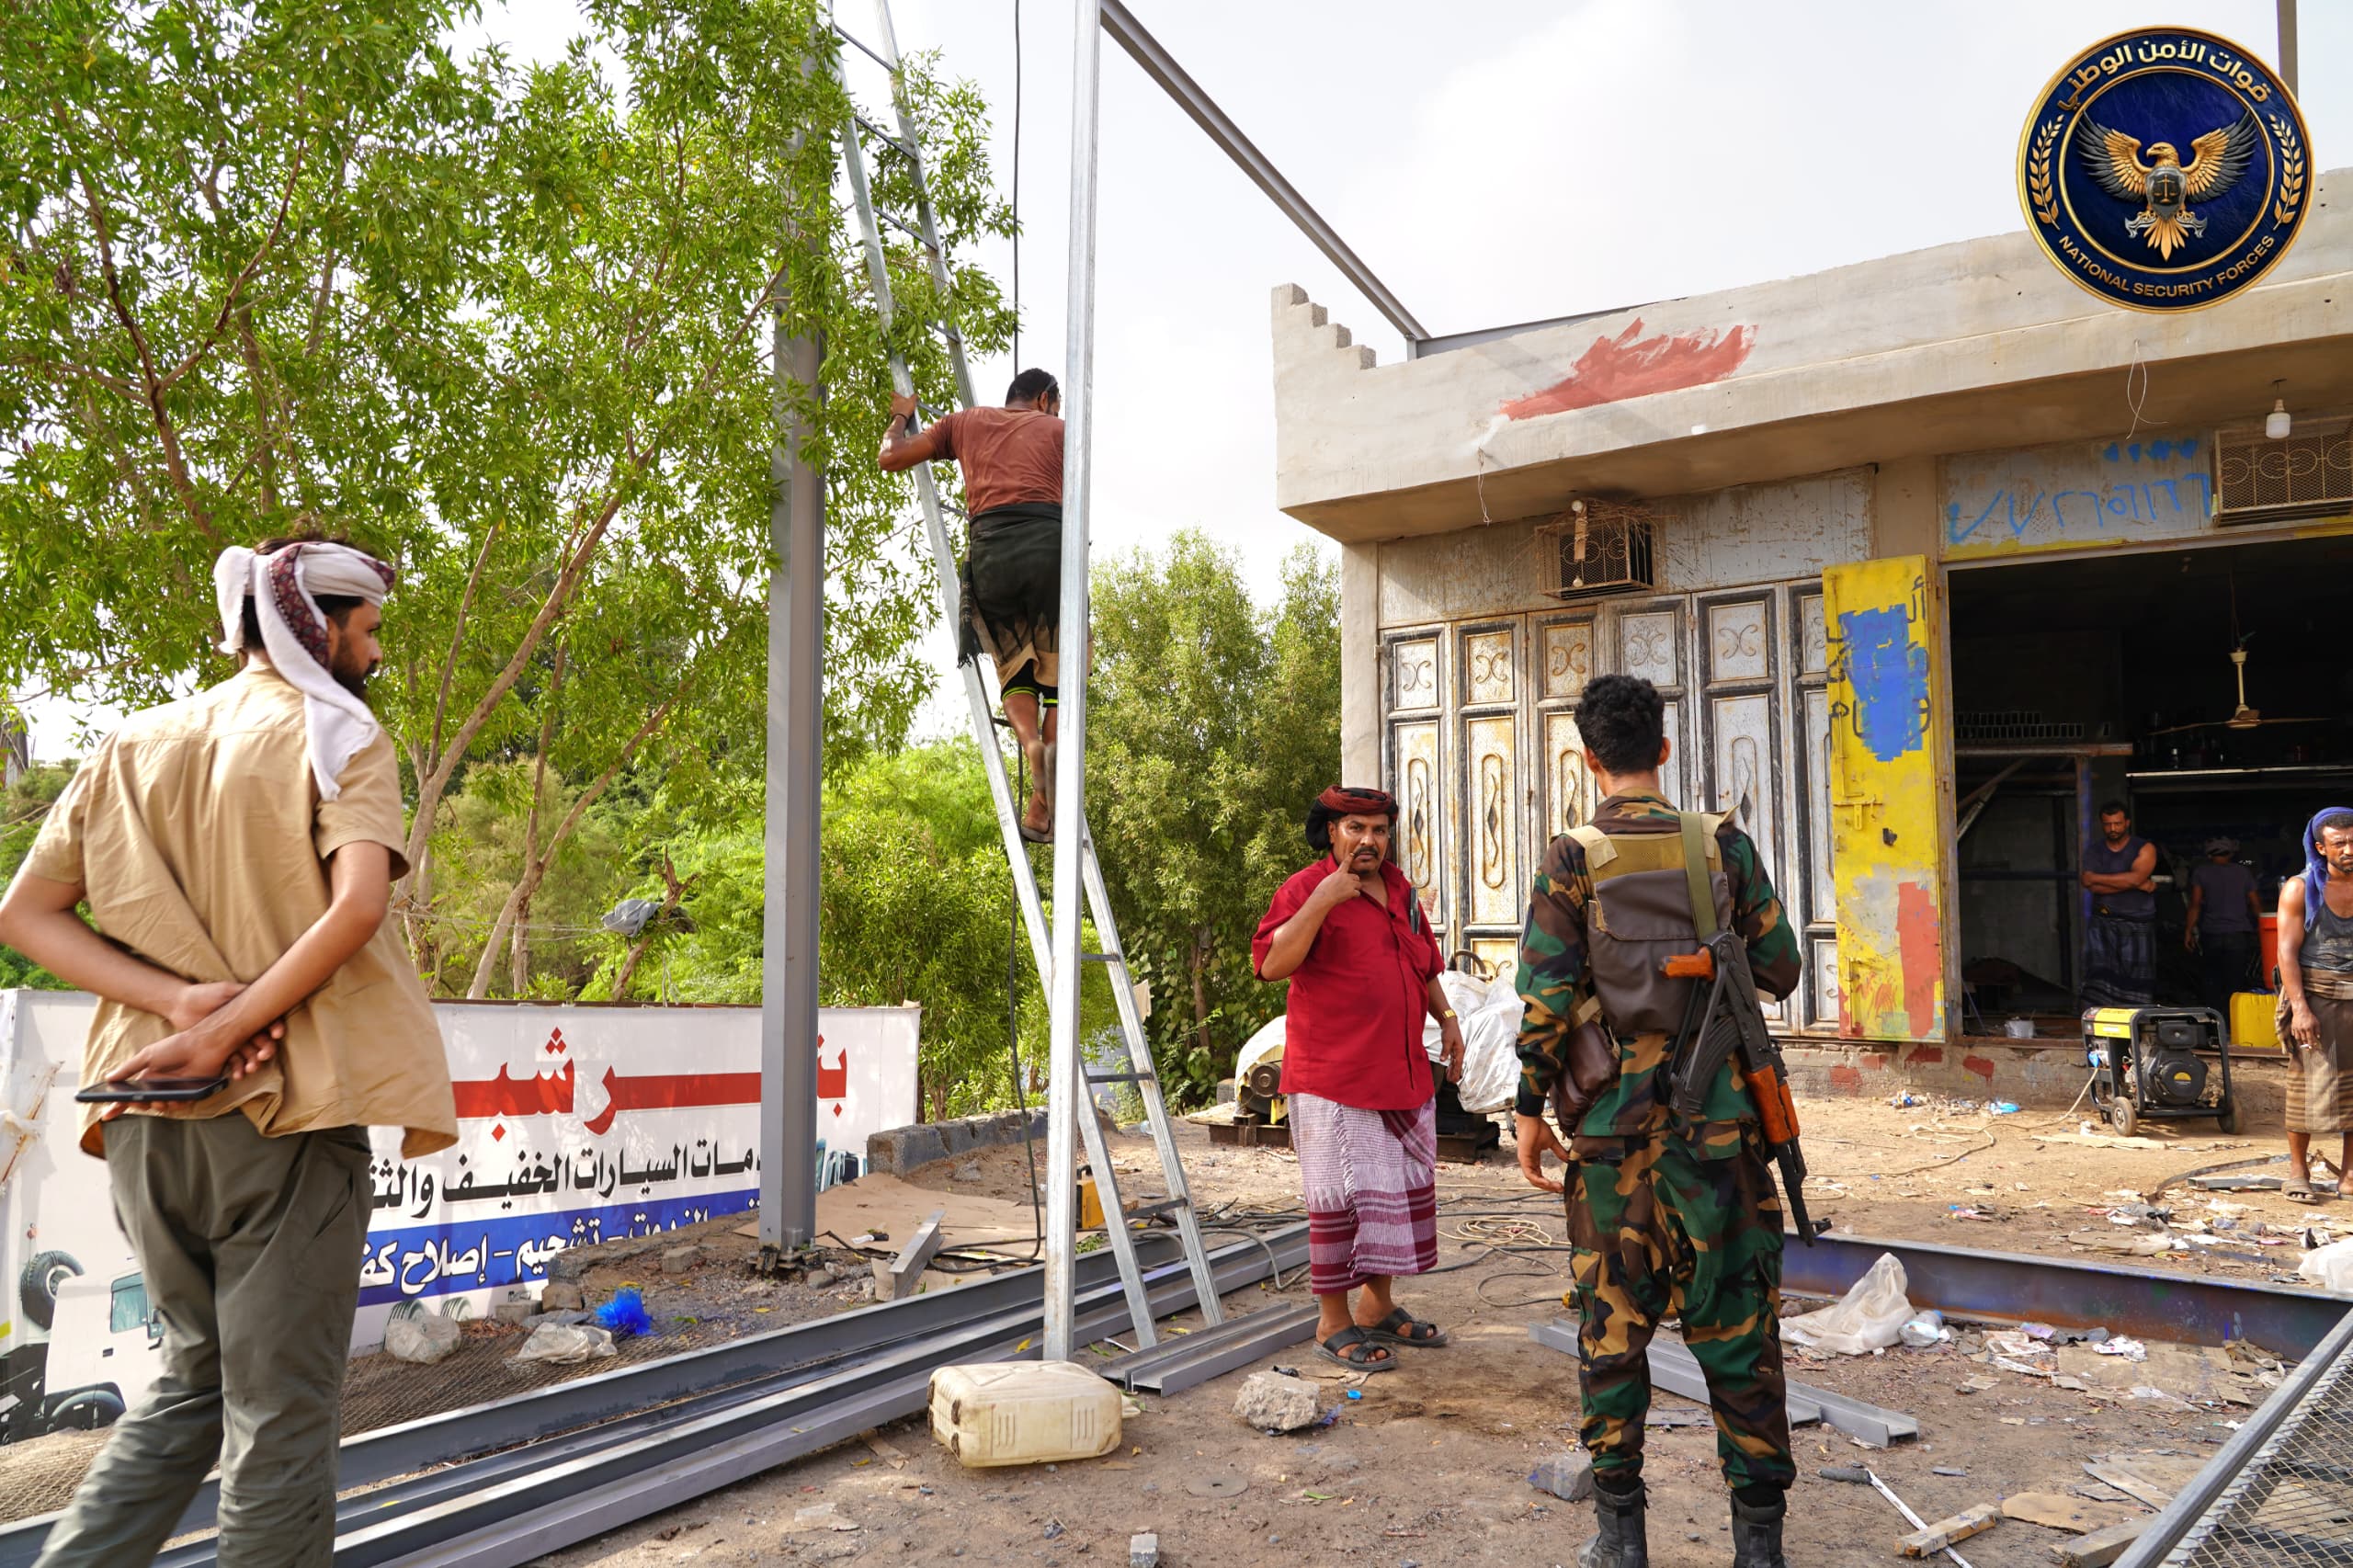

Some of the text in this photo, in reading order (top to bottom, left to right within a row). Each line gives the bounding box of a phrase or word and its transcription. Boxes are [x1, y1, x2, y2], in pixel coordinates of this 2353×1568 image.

[442, 1149, 570, 1210] الخفيف
[574, 1142, 688, 1199] السيارات
[691, 1139, 761, 1178] مات
[401, 1234, 487, 1295] إصلاح
[516, 1217, 601, 1280] تشحيم
